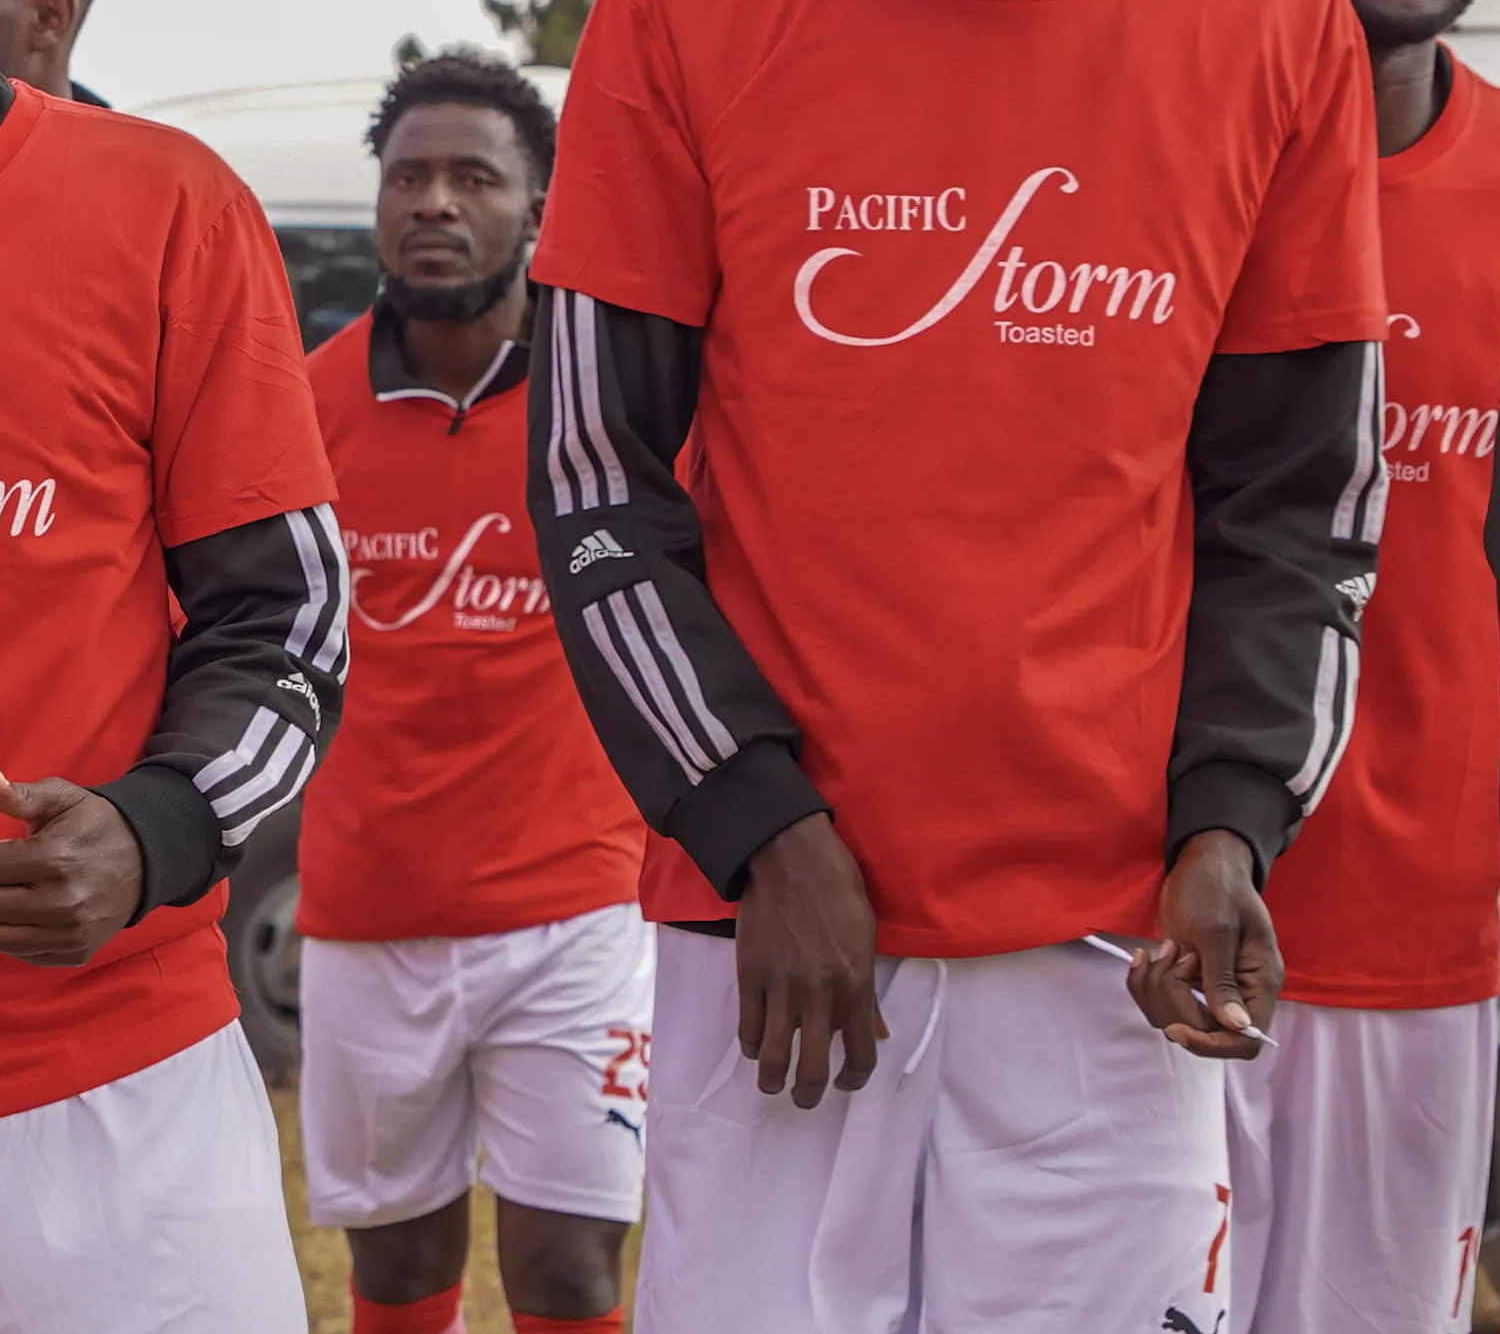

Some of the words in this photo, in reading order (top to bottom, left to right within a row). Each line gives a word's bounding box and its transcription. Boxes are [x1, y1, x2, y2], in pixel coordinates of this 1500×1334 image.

[806, 187, 966, 232] PACIFIC
[794, 166, 1176, 347] Storm
[994, 320, 1095, 347] Toasted
[1388, 461, 1430, 482] sted
